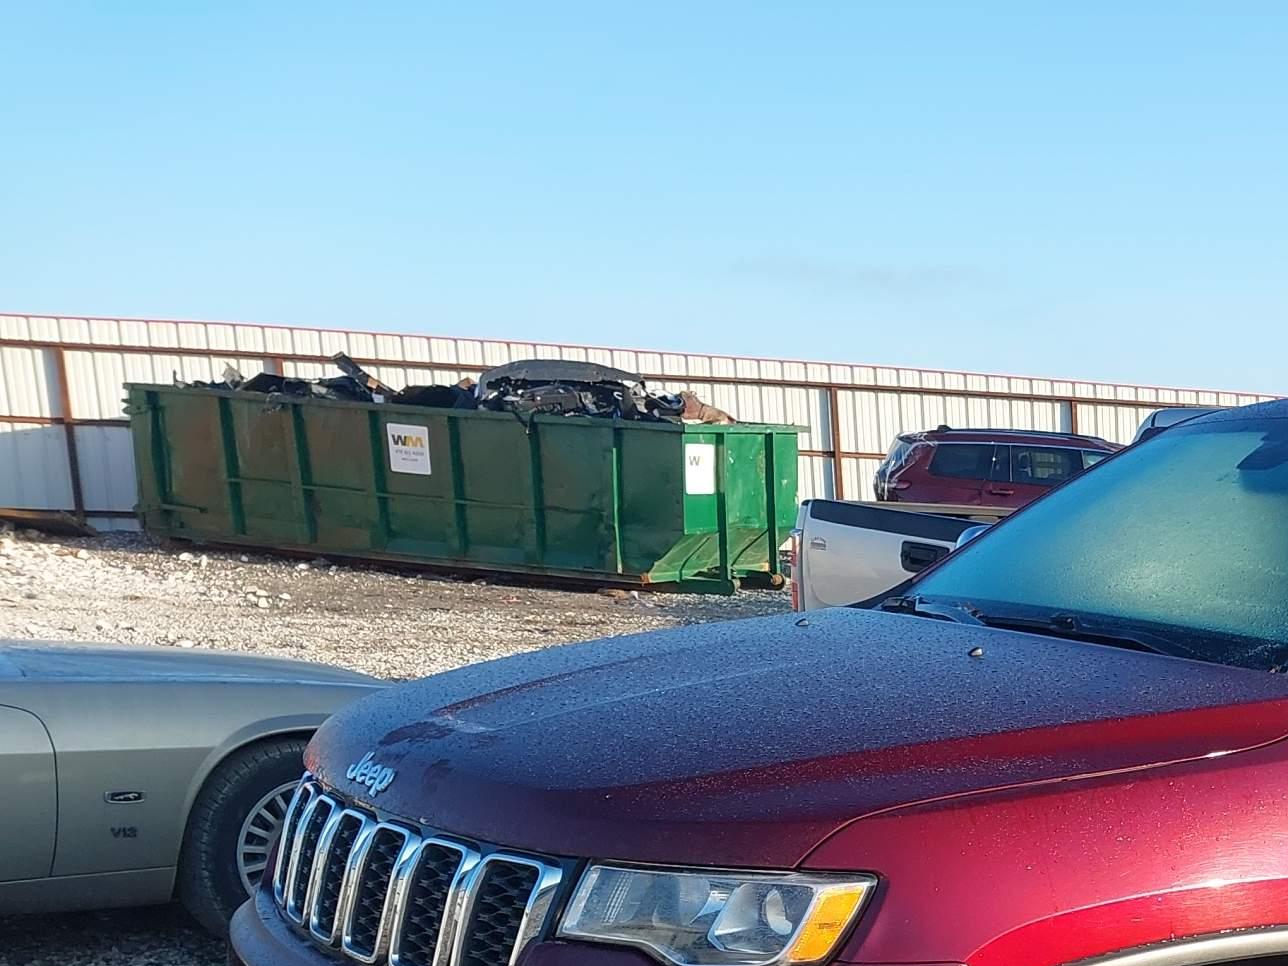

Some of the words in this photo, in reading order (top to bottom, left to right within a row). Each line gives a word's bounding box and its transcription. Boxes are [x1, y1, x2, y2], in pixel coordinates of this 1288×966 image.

[391, 434, 425, 448] WM
[346, 751, 396, 798] Jeep
[110, 826, 137, 838] V12
